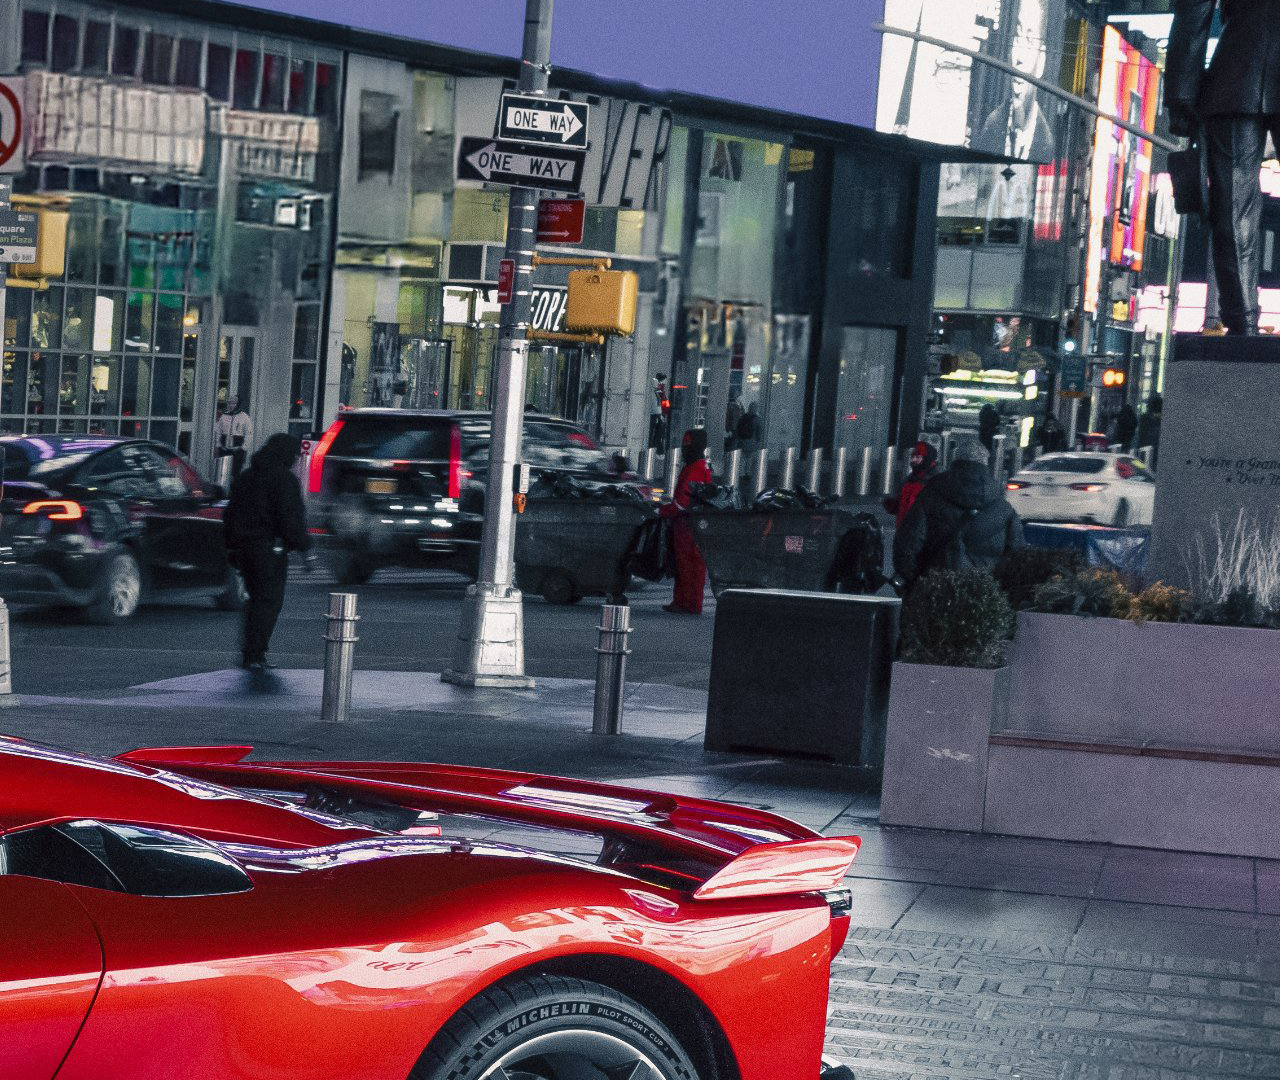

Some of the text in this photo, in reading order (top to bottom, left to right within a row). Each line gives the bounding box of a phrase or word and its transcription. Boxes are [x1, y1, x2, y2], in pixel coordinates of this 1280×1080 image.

[514, 110, 575, 132] ONE WAY
[478, 152, 567, 177] ONE WAY
[10, 235, 33, 243] Plaza
[506, 1003, 590, 1034] MICHELIN
[597, 1007, 622, 1019] PILOT
[623, 1015, 648, 1035] SPORT
[649, 1033, 664, 1047] CUP
